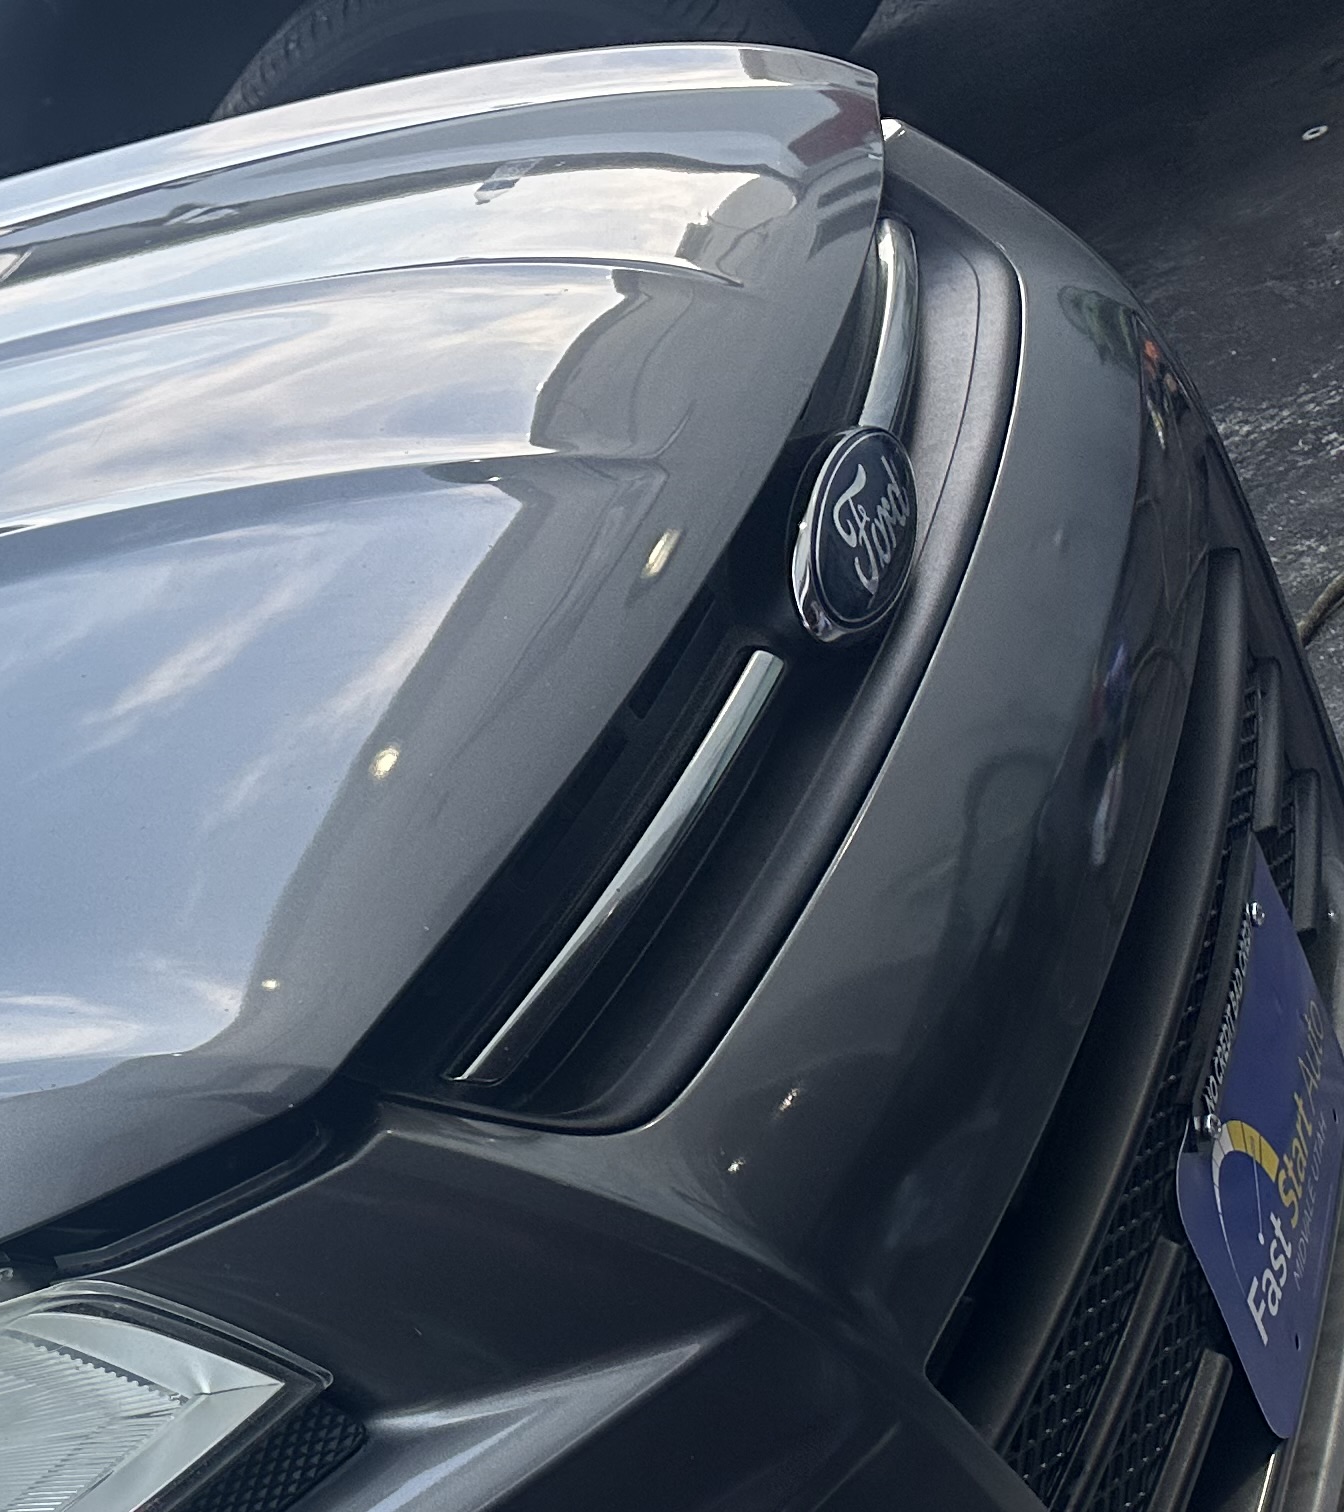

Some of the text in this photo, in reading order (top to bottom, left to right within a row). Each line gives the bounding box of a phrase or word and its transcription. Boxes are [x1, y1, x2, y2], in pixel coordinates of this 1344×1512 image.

[833, 455, 911, 609] Ford
[1203, 1074, 1219, 1113] NO
[1213, 1002, 1236, 1085] CREDIT
[1247, 1000, 1324, 1346] Fast Start Auto
[1293, 1110, 1327, 1292] MIDVALE UTAH
